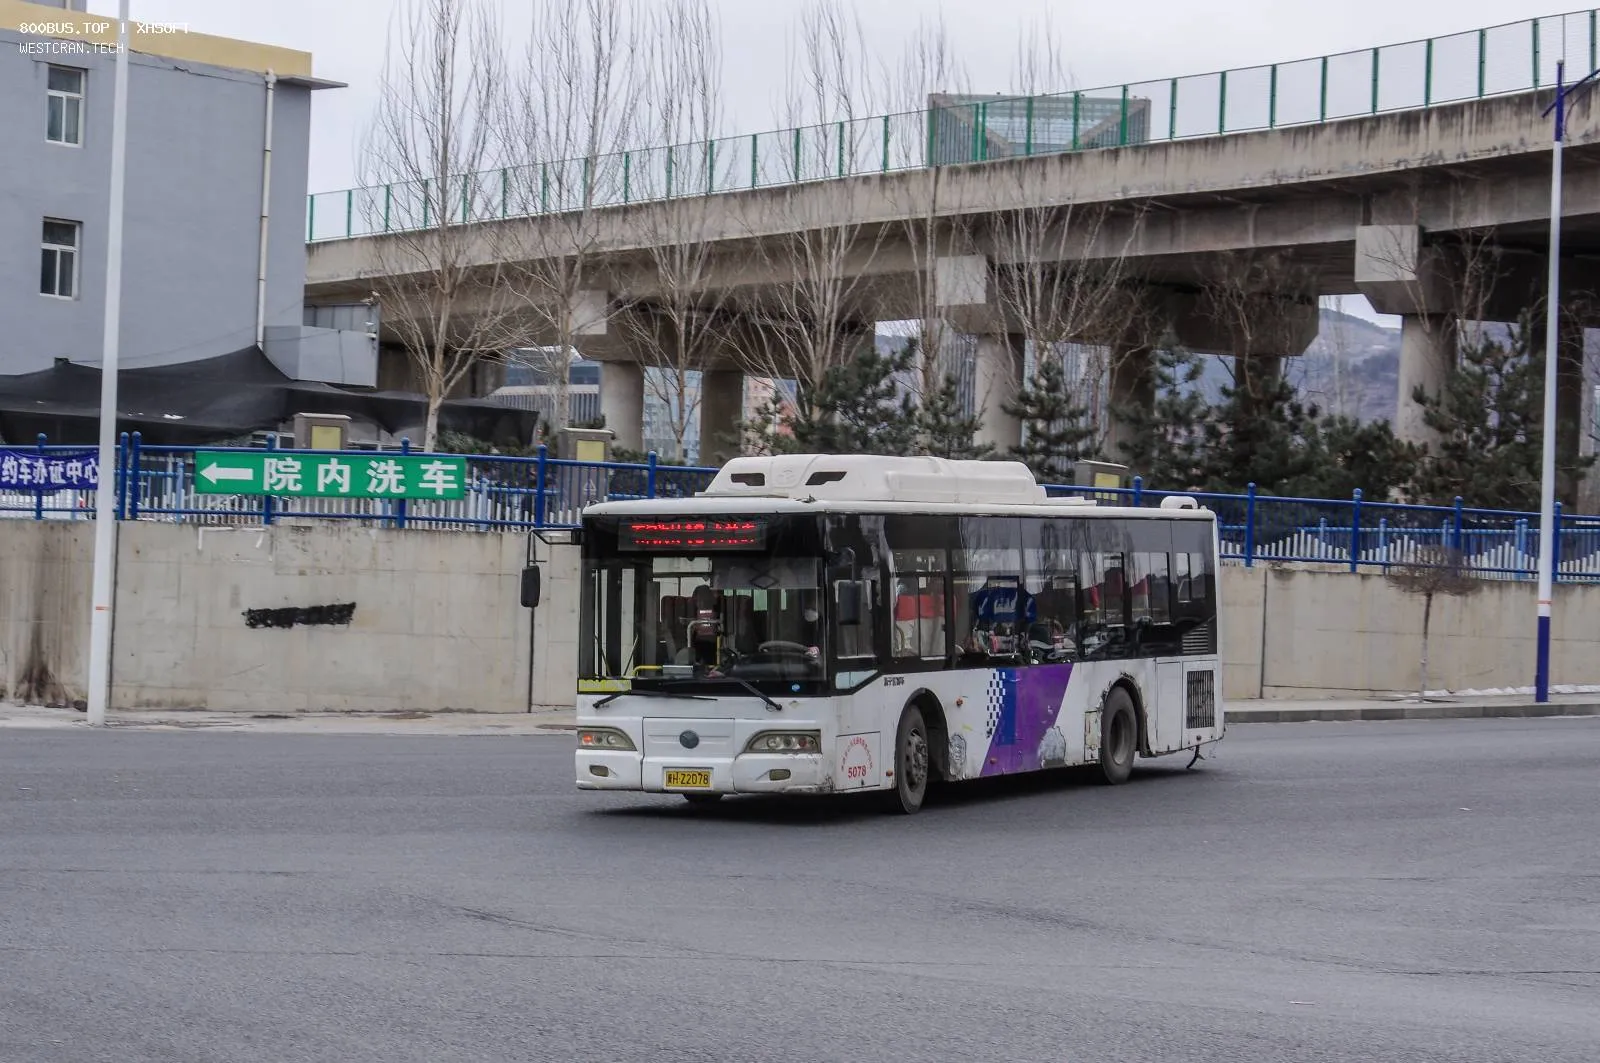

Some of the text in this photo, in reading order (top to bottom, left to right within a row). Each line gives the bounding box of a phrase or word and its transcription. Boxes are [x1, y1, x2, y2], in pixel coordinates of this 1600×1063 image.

[0, 456, 99, 485] 约车办证中心
[263, 457, 458, 495] 院内洗车
[848, 765, 867, 779] 5078
